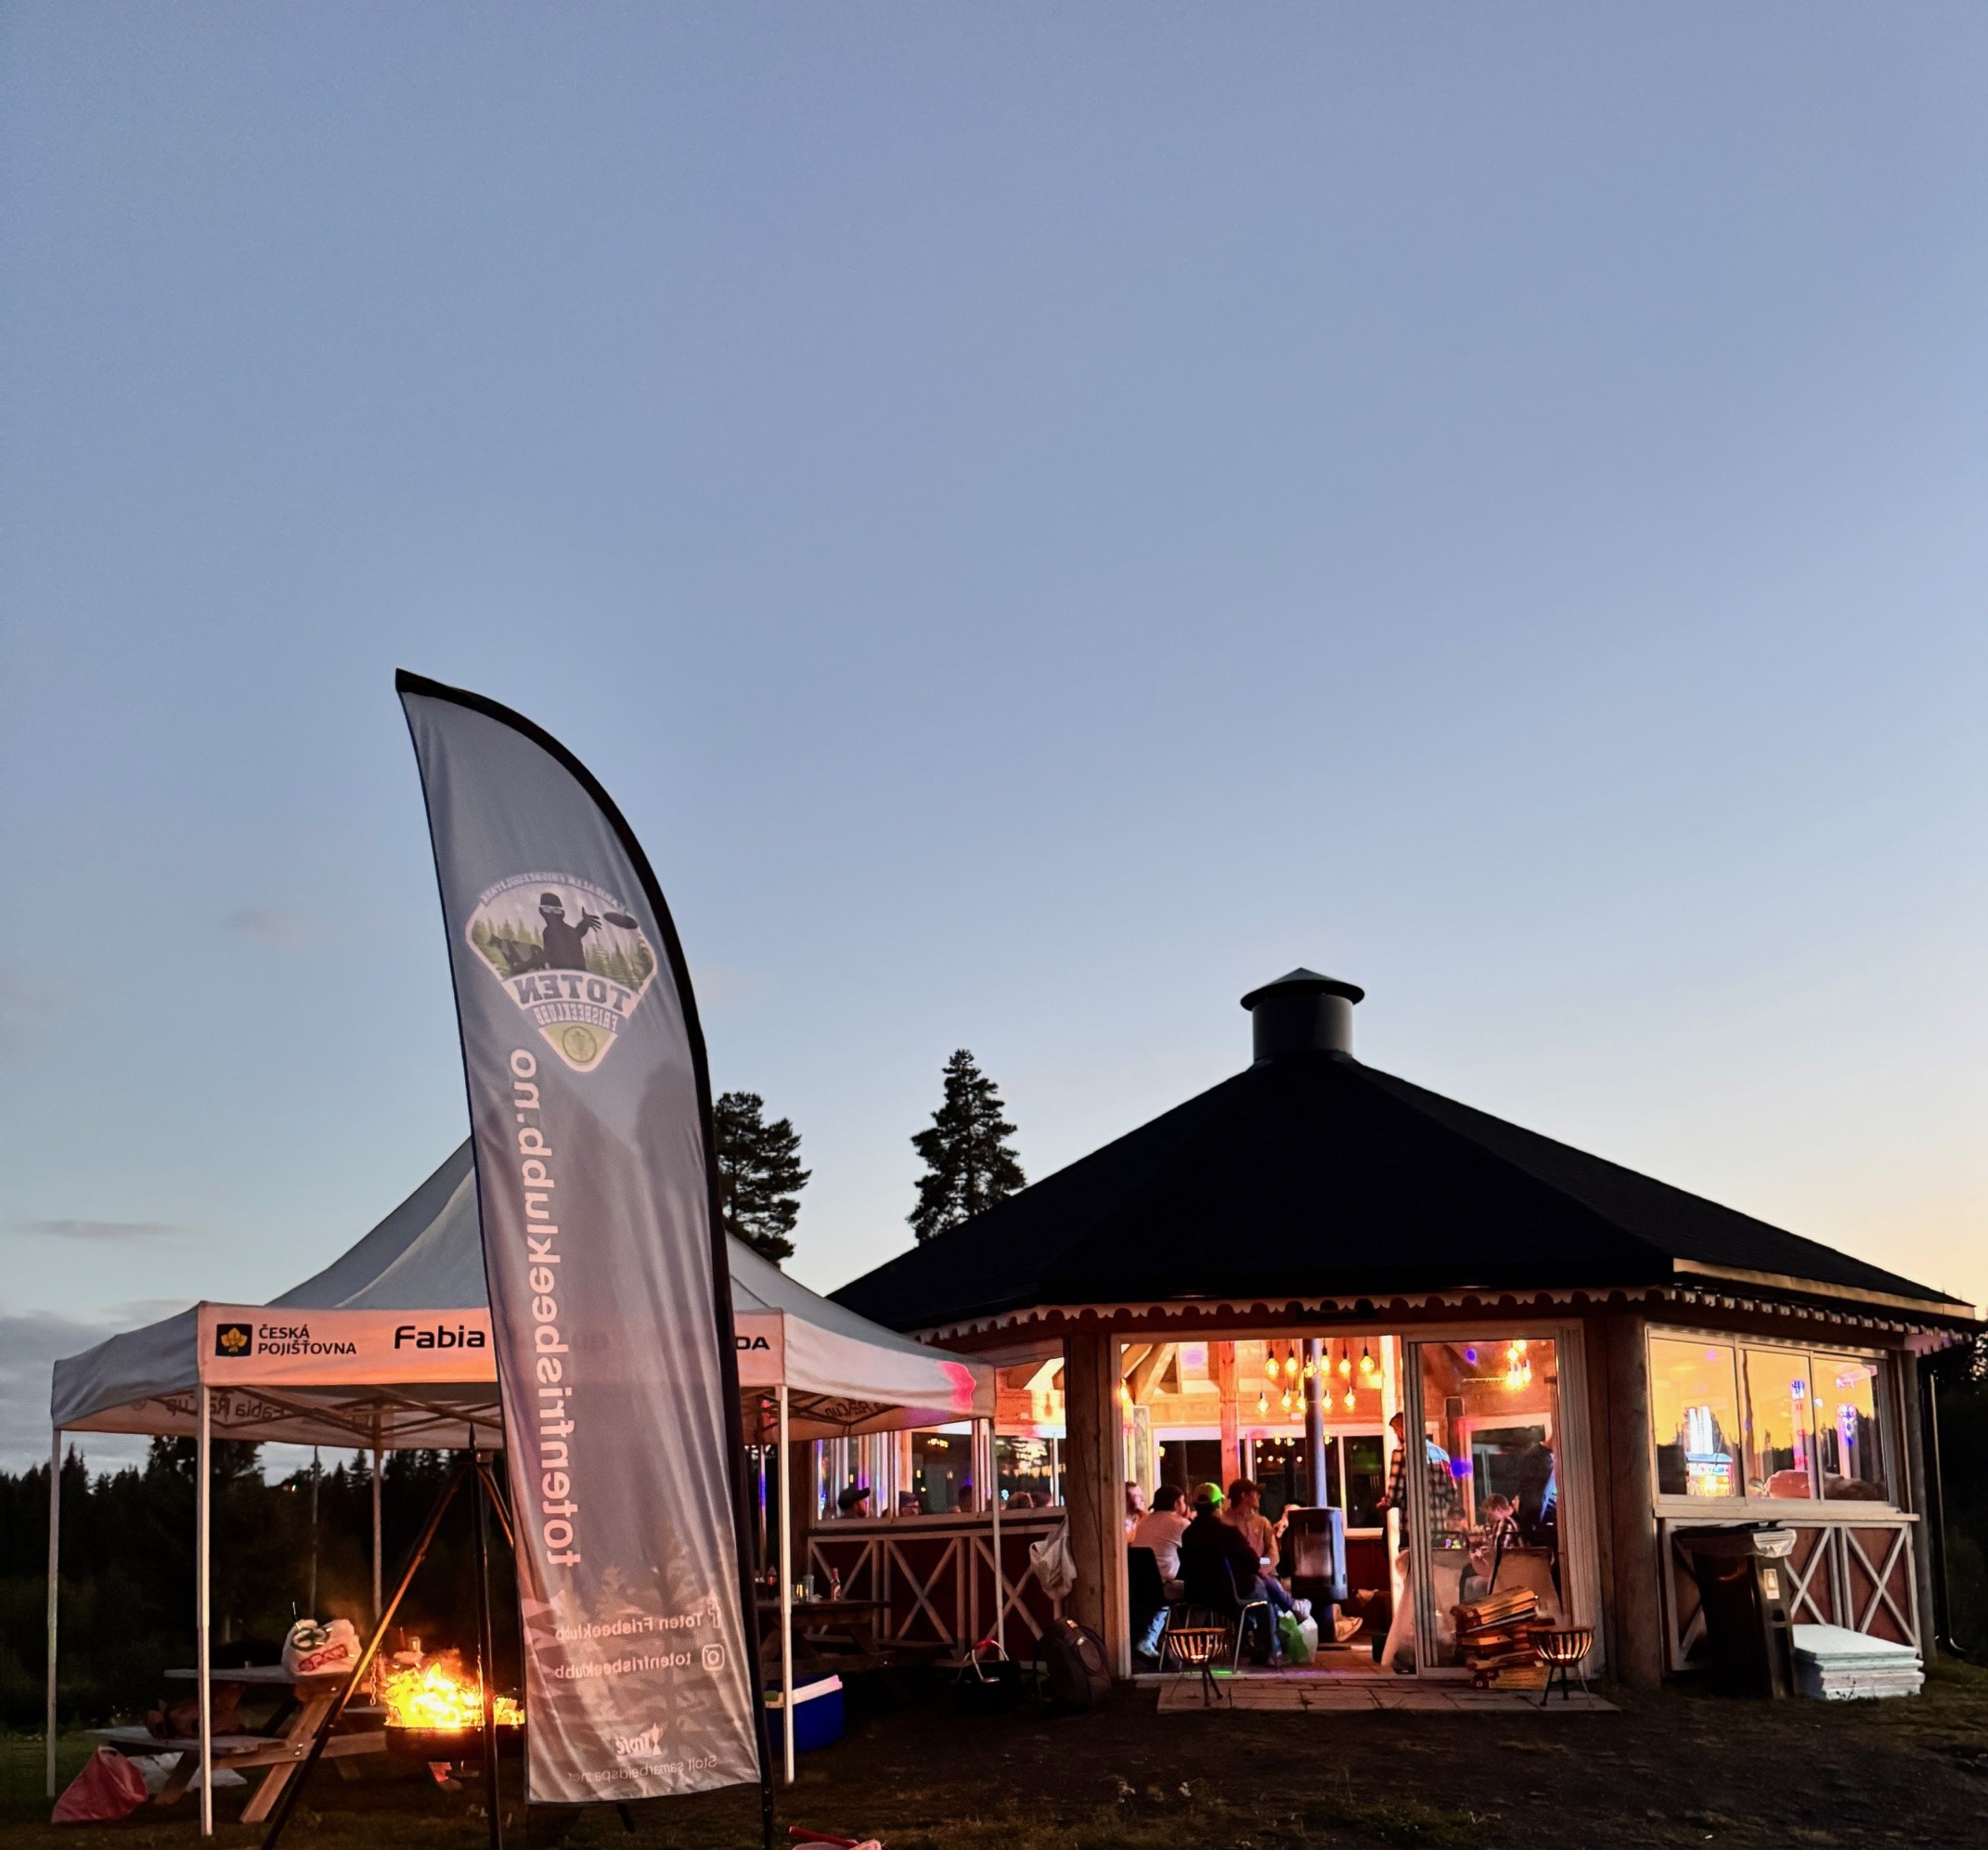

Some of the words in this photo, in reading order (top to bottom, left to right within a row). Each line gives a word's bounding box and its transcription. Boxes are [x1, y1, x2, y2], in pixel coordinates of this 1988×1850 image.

[258, 1323, 309, 1339] ČESKÁ
[394, 1325, 485, 1350] Fabia
[257, 1338, 357, 1355] POJIŠŤOVNA
